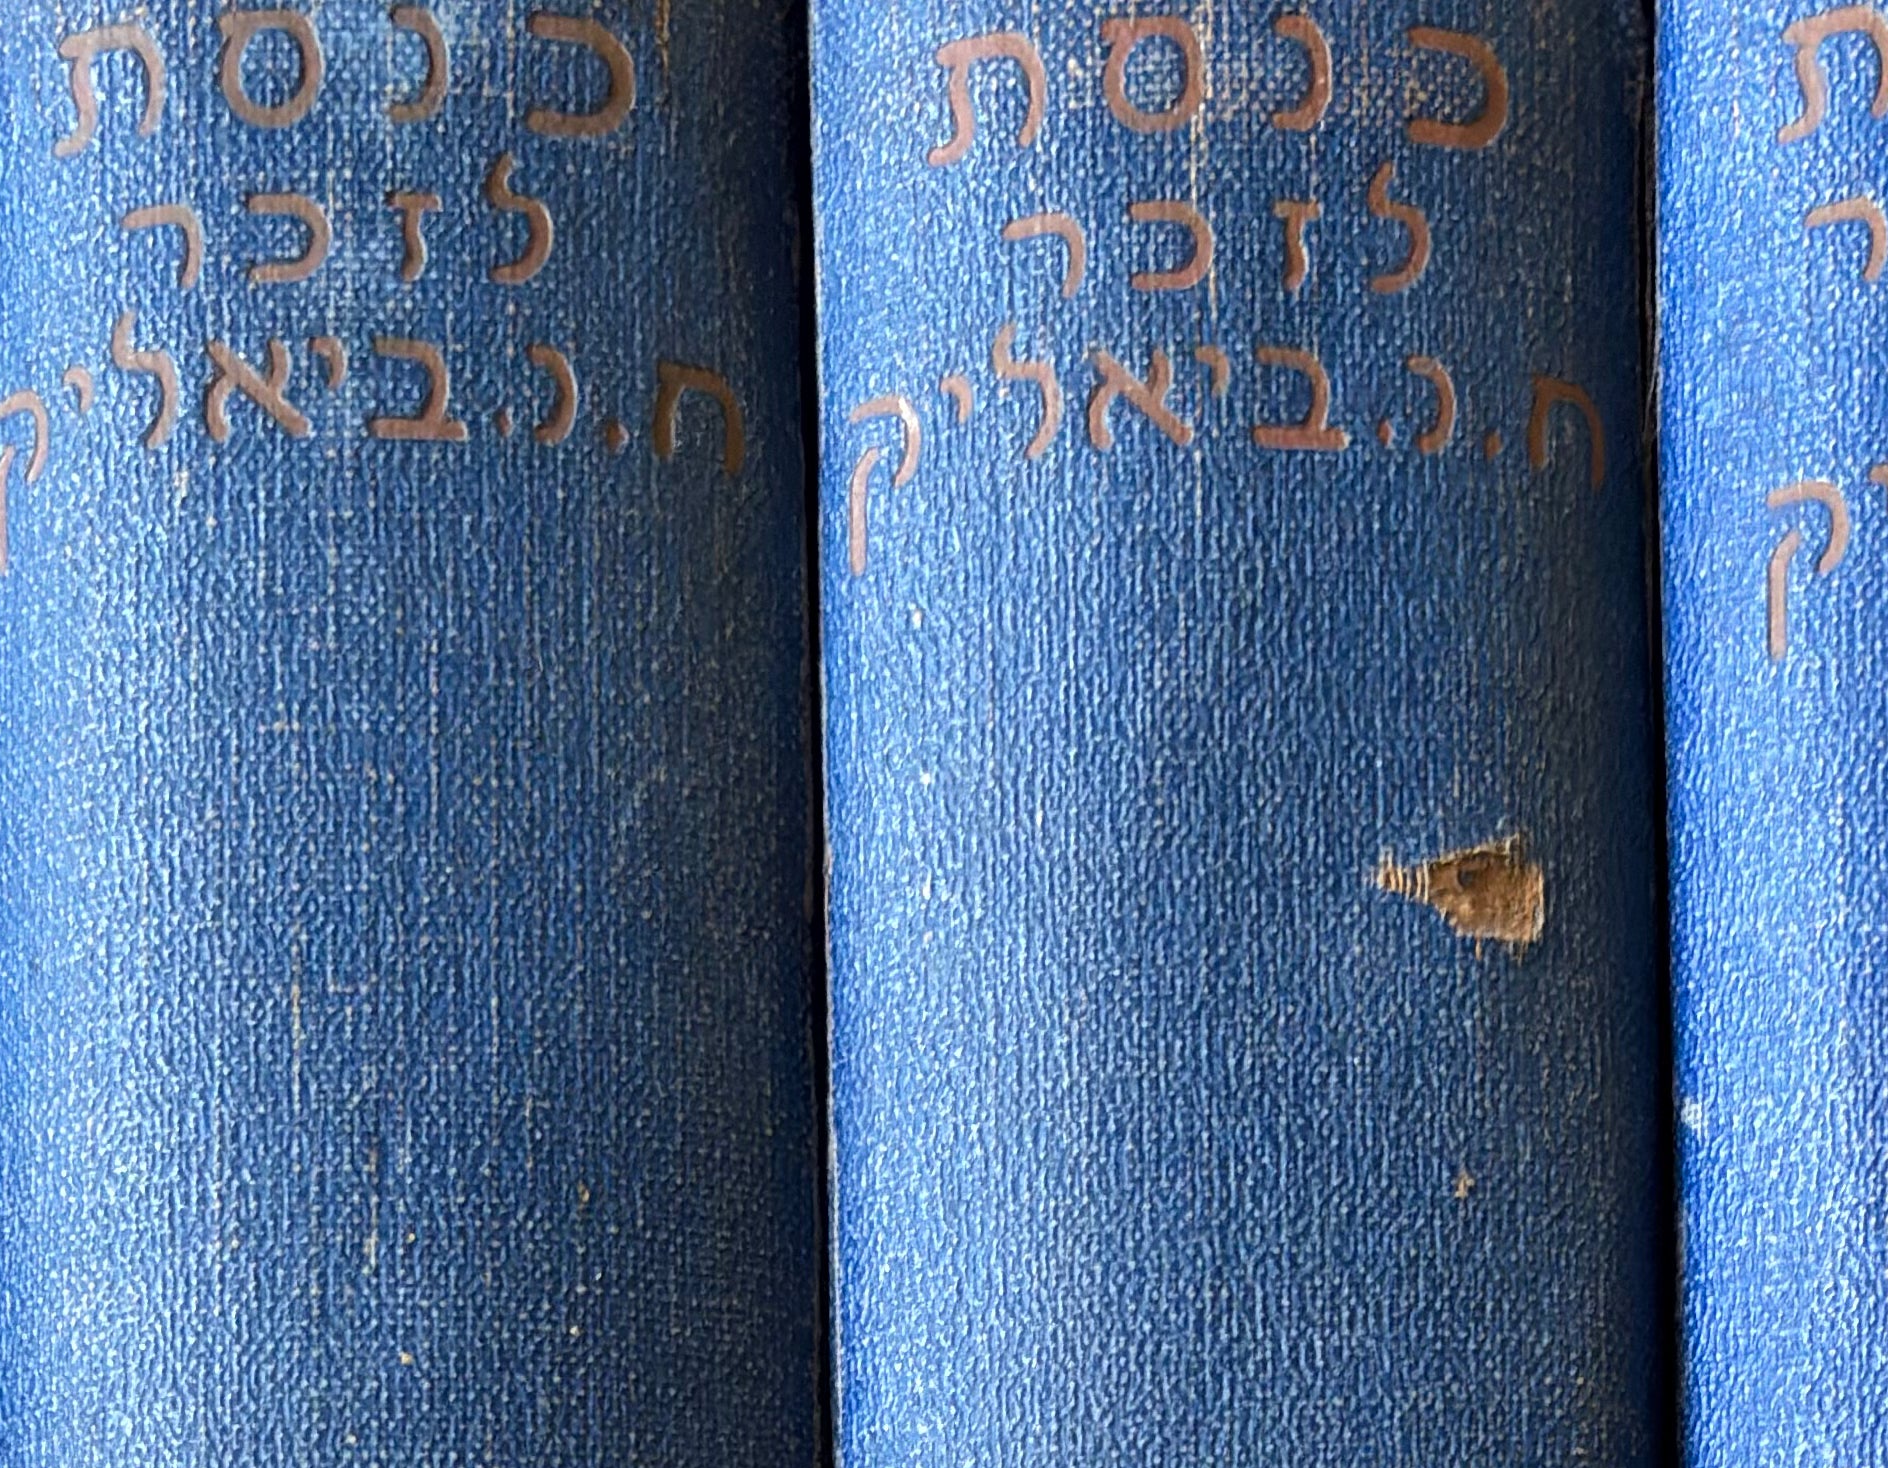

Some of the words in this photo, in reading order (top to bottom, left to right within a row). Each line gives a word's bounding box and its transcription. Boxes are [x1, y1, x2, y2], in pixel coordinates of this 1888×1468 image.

[53, 7, 636, 158] כנסת
[927, 15, 1511, 167] כנסת
[121, 152, 555, 290] לזכר
[1002, 161, 1433, 299] לזכר
